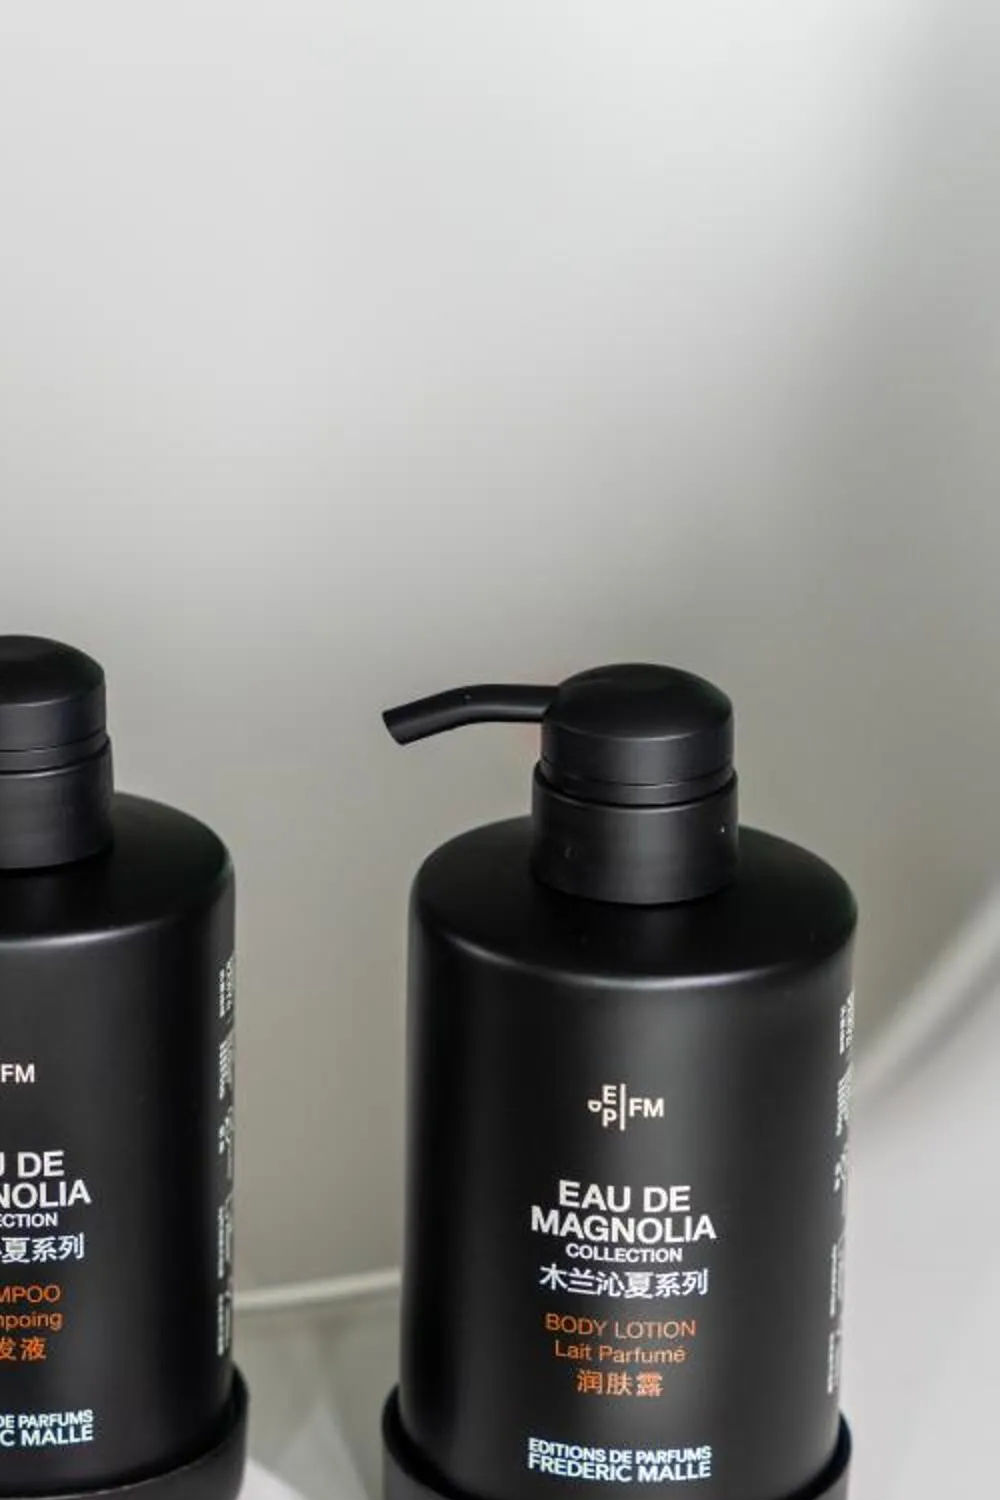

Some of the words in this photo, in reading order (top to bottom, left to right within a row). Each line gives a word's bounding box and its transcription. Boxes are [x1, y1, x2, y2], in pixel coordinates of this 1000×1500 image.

[16, 1150, 65, 1178] DE
[558, 1179, 632, 1213] EAU
[643, 1186, 692, 1213] DE
[530, 1205, 718, 1244] MAGNOLIA
[565, 1242, 683, 1263] COLLECTION
[539, 1263, 709, 1300] 木兰沁夏系列
[544, 1312, 607, 1337] BODY
[614, 1320, 697, 1339] LOTION
[554, 1339, 592, 1361] Lait
[599, 1345, 687, 1363] Parfumé
[576, 1369, 664, 1397] 润肤露
[18, 1409, 95, 1430] PARFUMS
[20, 1423, 95, 1447] MALLE
[527, 1437, 607, 1464] EDITIONS
[609, 1448, 633, 1466] DE
[635, 1445, 713, 1466] PARFUMS
[527, 1451, 633, 1483] FREDERIC
[636, 1460, 713, 1483] MALLE
